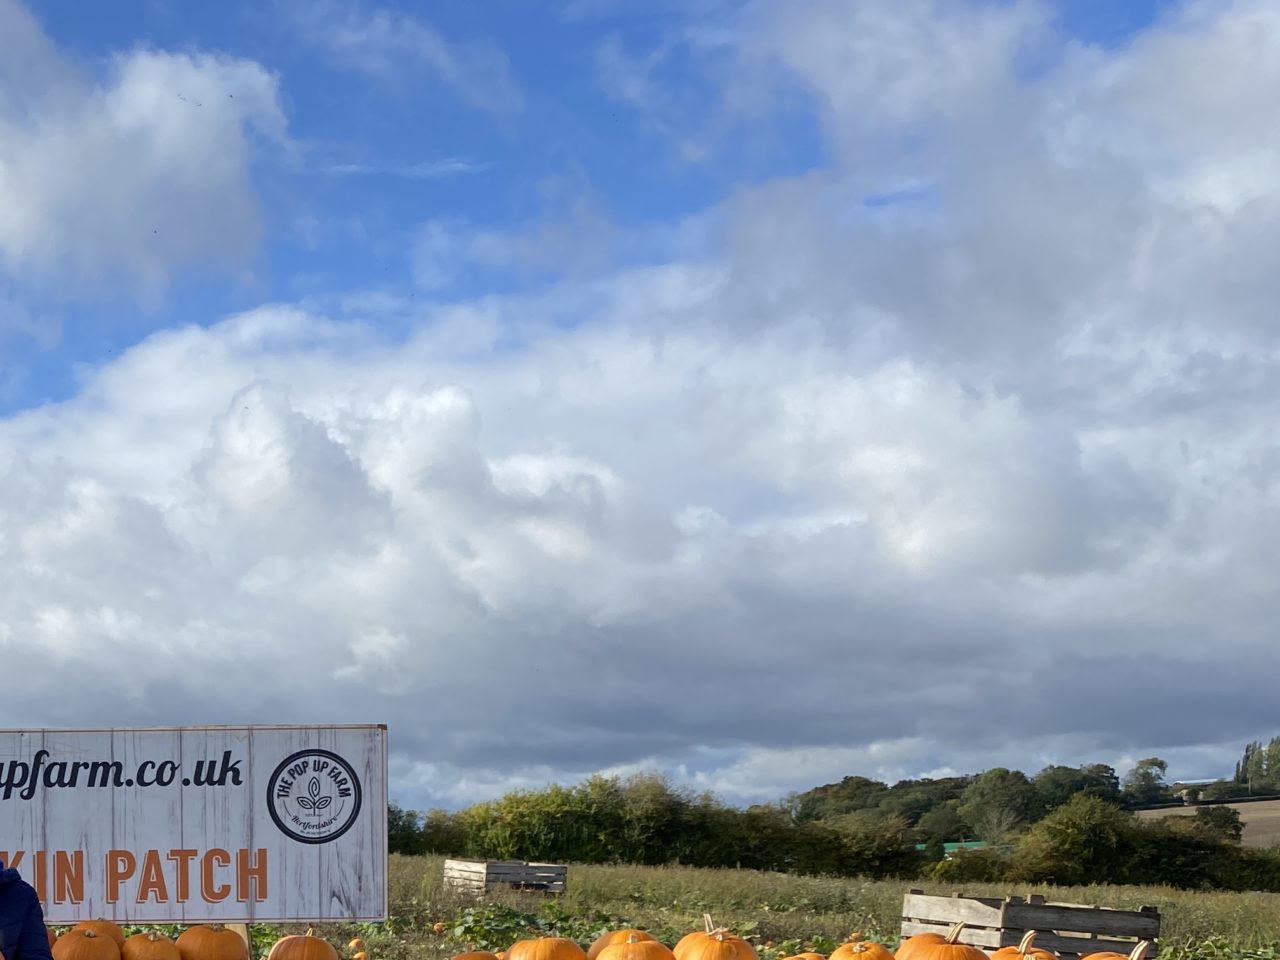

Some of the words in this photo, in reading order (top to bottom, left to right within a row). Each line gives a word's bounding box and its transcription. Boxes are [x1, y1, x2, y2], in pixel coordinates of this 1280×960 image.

[277, 777, 294, 799] THE
[287, 761, 309, 780] POP
[313, 759, 329, 773] UP
[327, 766, 351, 798] FARM
[291, 815, 338, 830] Hertfordshire
[105, 848, 268, 904] PATCH
